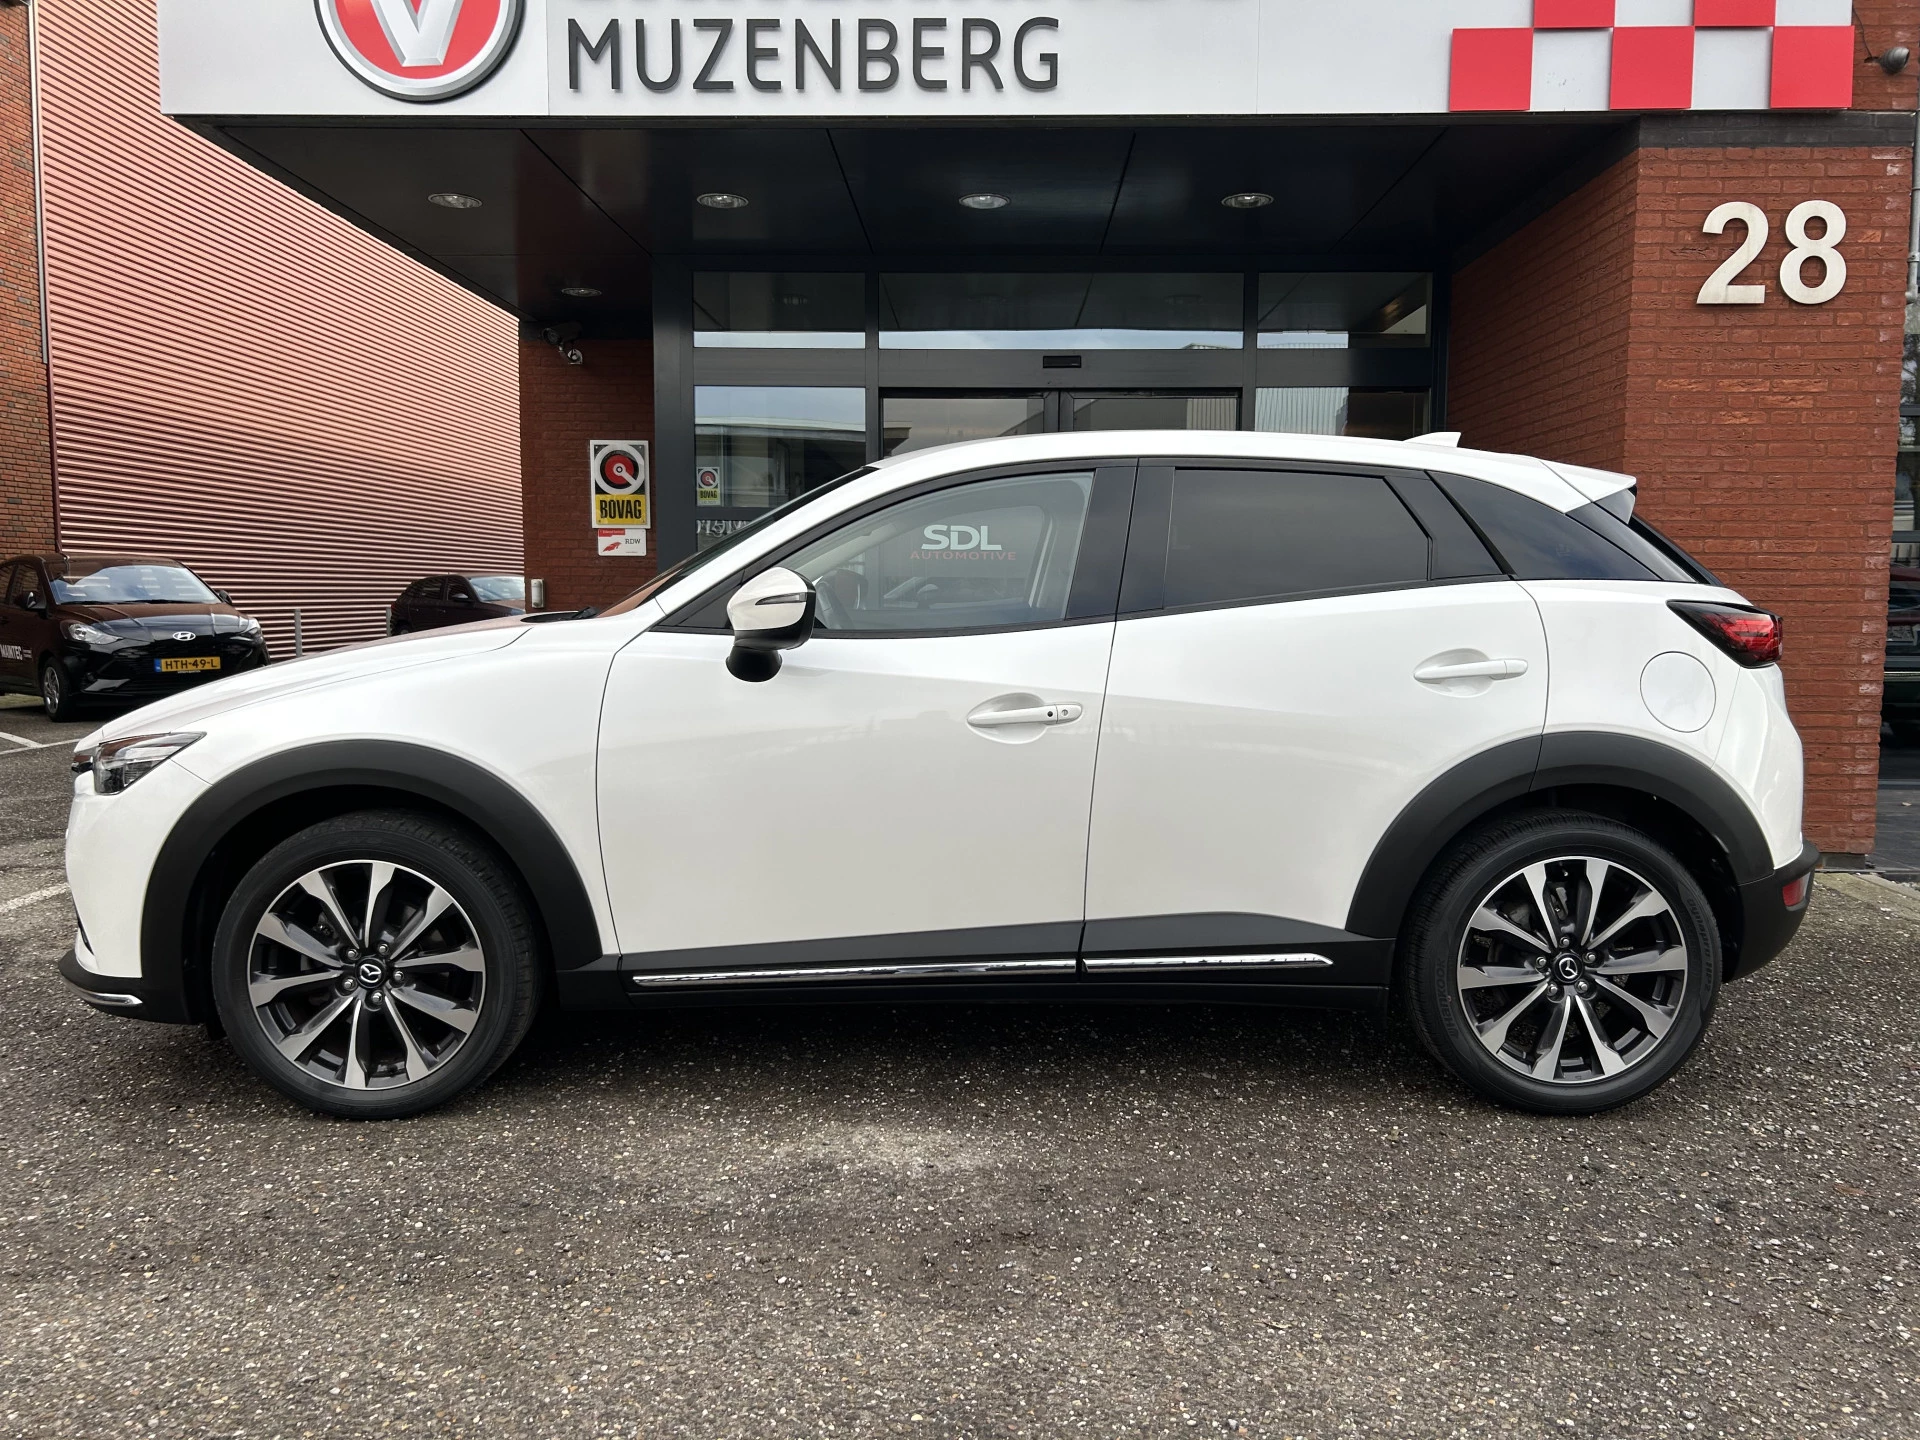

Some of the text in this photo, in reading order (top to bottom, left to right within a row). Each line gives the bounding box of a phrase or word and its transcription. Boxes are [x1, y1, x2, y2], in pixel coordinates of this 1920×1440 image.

[569, 17, 1059, 91] MUZENBERG
[1697, 201, 1847, 304] 28
[700, 490, 717, 498] BOVAG
[600, 500, 642, 519] BOVAG
[921, 525, 1002, 550] SDL
[910, 552, 1016, 560] AUTOMOTIVE
[165, 658, 218, 670] HTH-49-L
